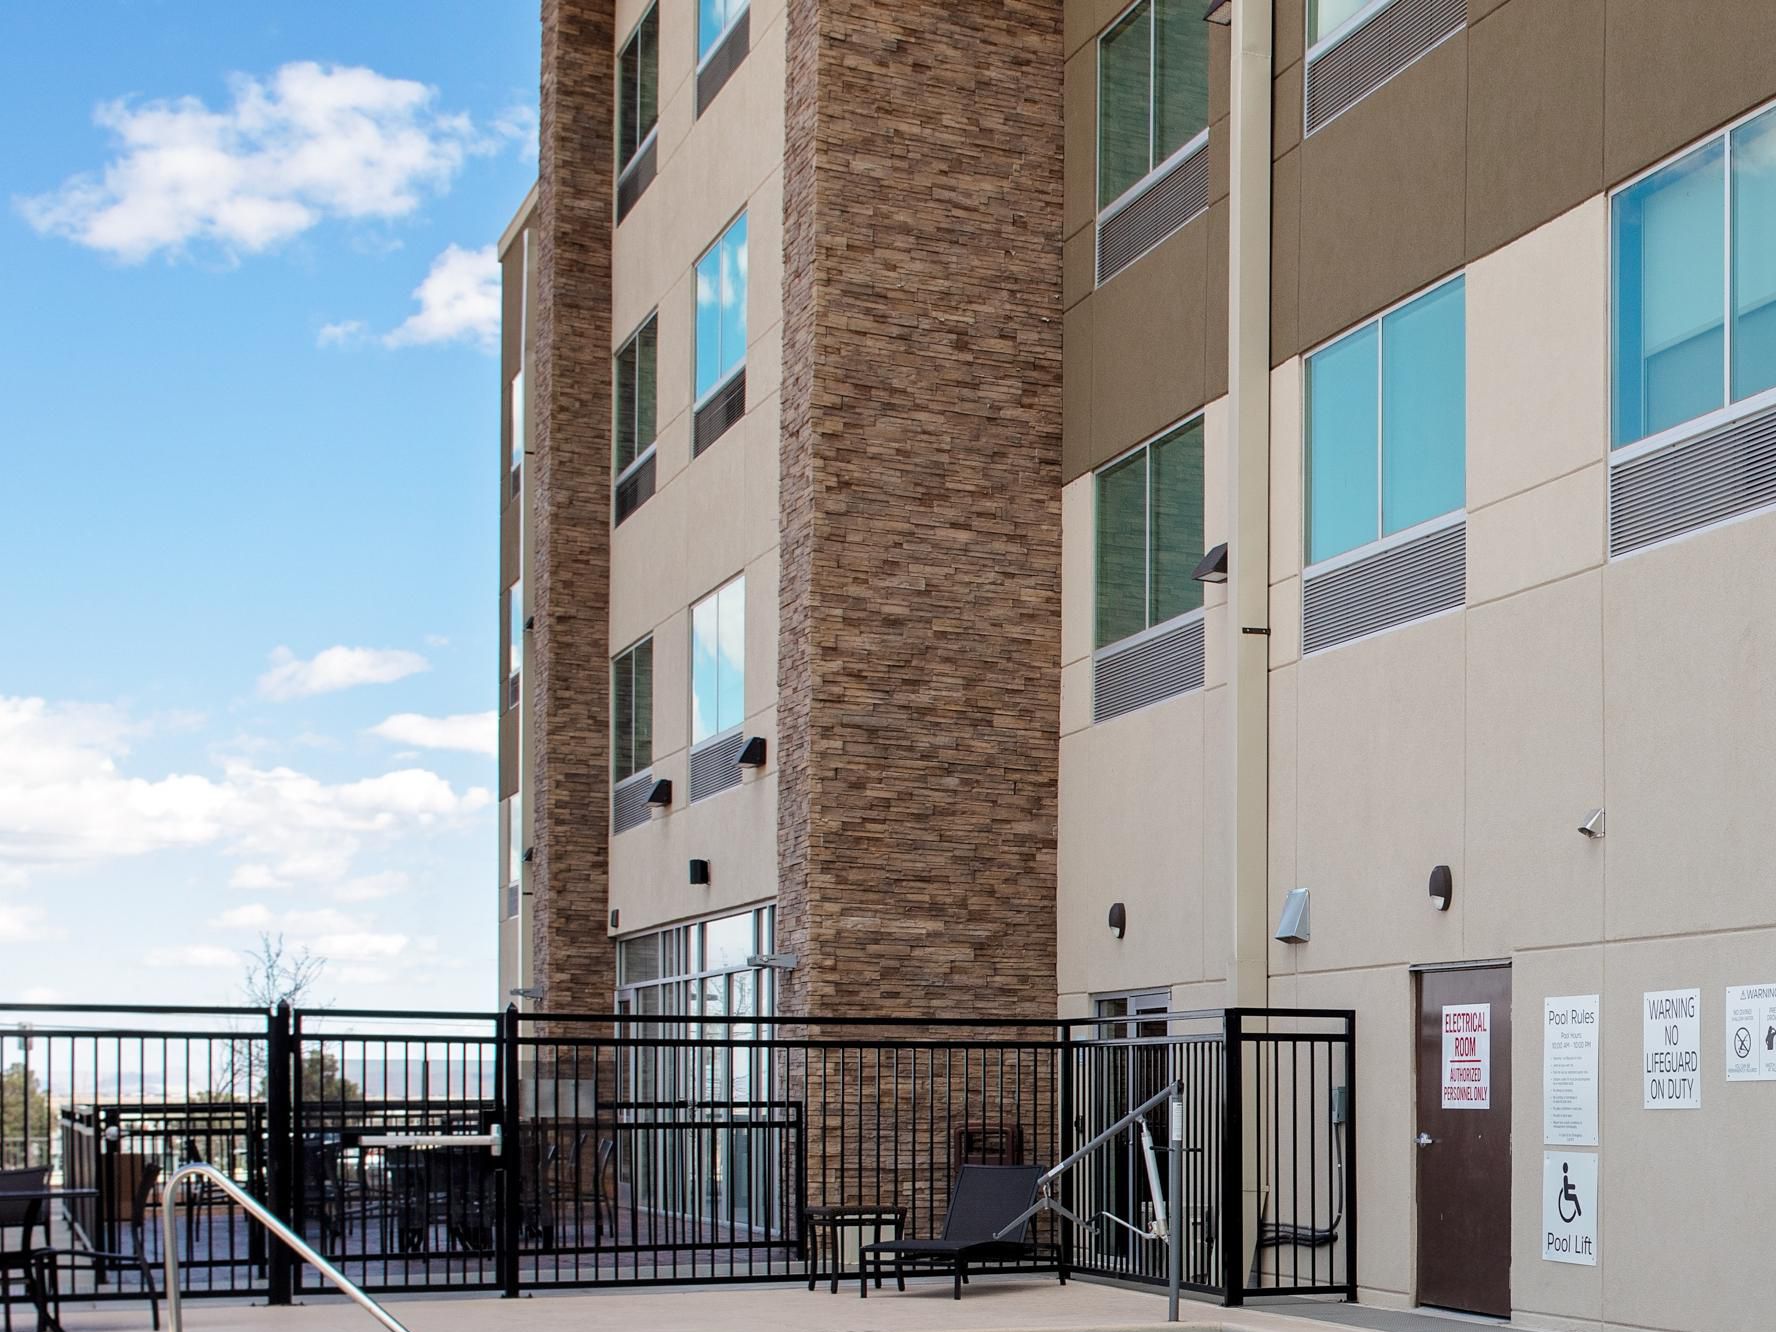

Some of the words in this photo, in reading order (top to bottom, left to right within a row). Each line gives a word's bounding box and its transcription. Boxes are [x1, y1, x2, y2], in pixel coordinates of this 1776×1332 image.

[1549, 1010, 1568, 1025] Pool
[1571, 1009, 1595, 1024] Rules
[1649, 997, 1695, 1020] WARNING
[1445, 1012, 1487, 1033] ELECTRICAL
[1665, 1025, 1679, 1046] NO
[1455, 1037, 1476, 1057] ROOM
[1646, 1051, 1698, 1073] LIFEGUARD
[1450, 1067, 1481, 1082] AUTHORIZED
[1444, 1086, 1473, 1101] PERSONNEL
[1474, 1086, 1488, 1101] ONLY
[1650, 1078, 1664, 1099] ON
[1668, 1078, 1694, 1099] DUTY
[1547, 1232, 1571, 1252] Pool
[1575, 1234, 1592, 1255] Lift
